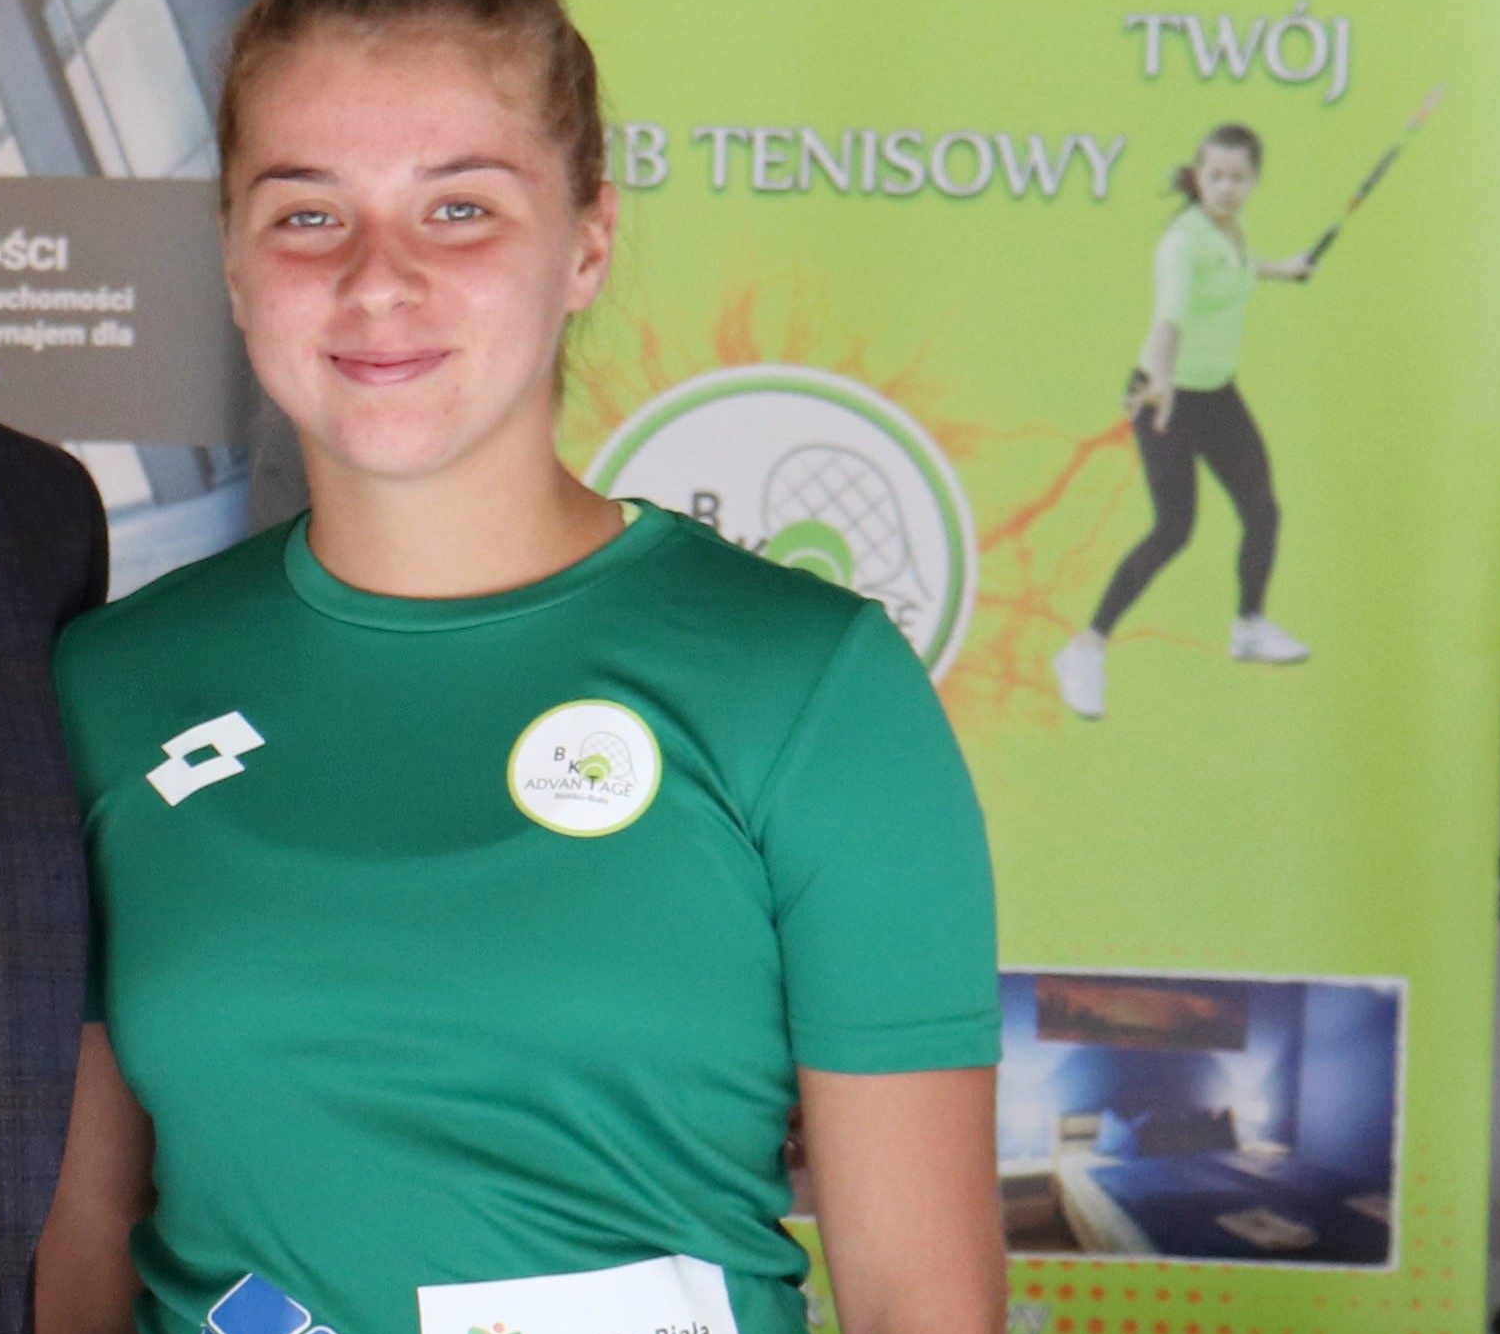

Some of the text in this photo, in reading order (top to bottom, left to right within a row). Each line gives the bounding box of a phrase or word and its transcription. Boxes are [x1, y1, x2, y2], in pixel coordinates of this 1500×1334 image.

[1125, 0, 1352, 105] TWÓJ
[693, 126, 1128, 199] TENISOWY
[91, 321, 136, 347] dla
[553, 746, 567, 762] B
[568, 760, 582, 775] K
[524, 776, 635, 798] ADVANTAGE
